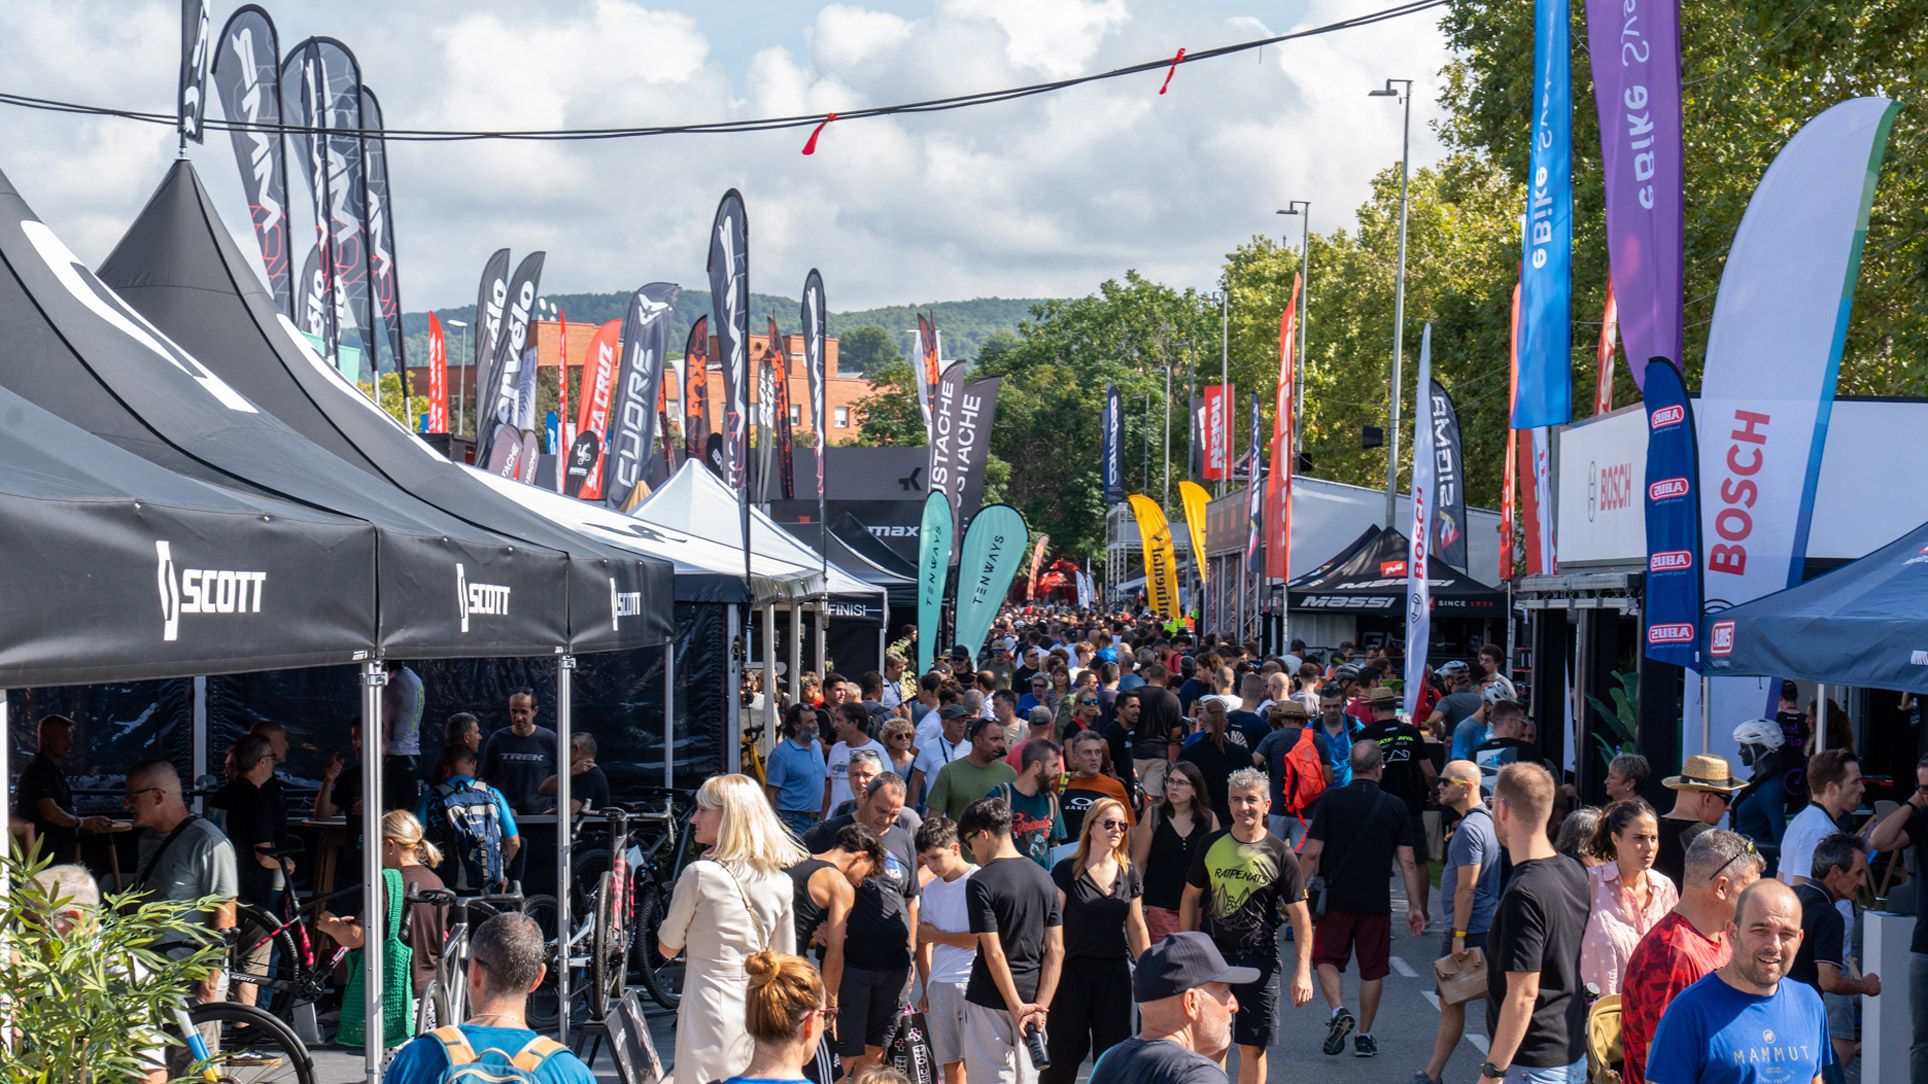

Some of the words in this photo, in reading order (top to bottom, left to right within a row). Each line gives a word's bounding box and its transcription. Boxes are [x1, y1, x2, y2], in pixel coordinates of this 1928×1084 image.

[495, 281, 534, 428] ervélo
[594, 341, 613, 408] CRUZ
[687, 354, 706, 418] FOX
[618, 342, 653, 487] CUORE
[1600, 463, 1632, 511] BOSCH
[1708, 409, 1771, 576] BOSCH
[1413, 486, 1425, 580] BOSCH
[181, 569, 267, 613] SCOTT
[926, 526, 942, 606] TENWAYS
[972, 535, 1004, 605] TENWAYS
[468, 583, 511, 615] SCOTT
[617, 592, 641, 616] SCOTT
[1438, 600, 1466, 608] SINCE
[500, 752, 544, 761] TREK
[231, 974, 257, 983] SCOTT
[1733, 1045, 1809, 1066] MAMMUT
